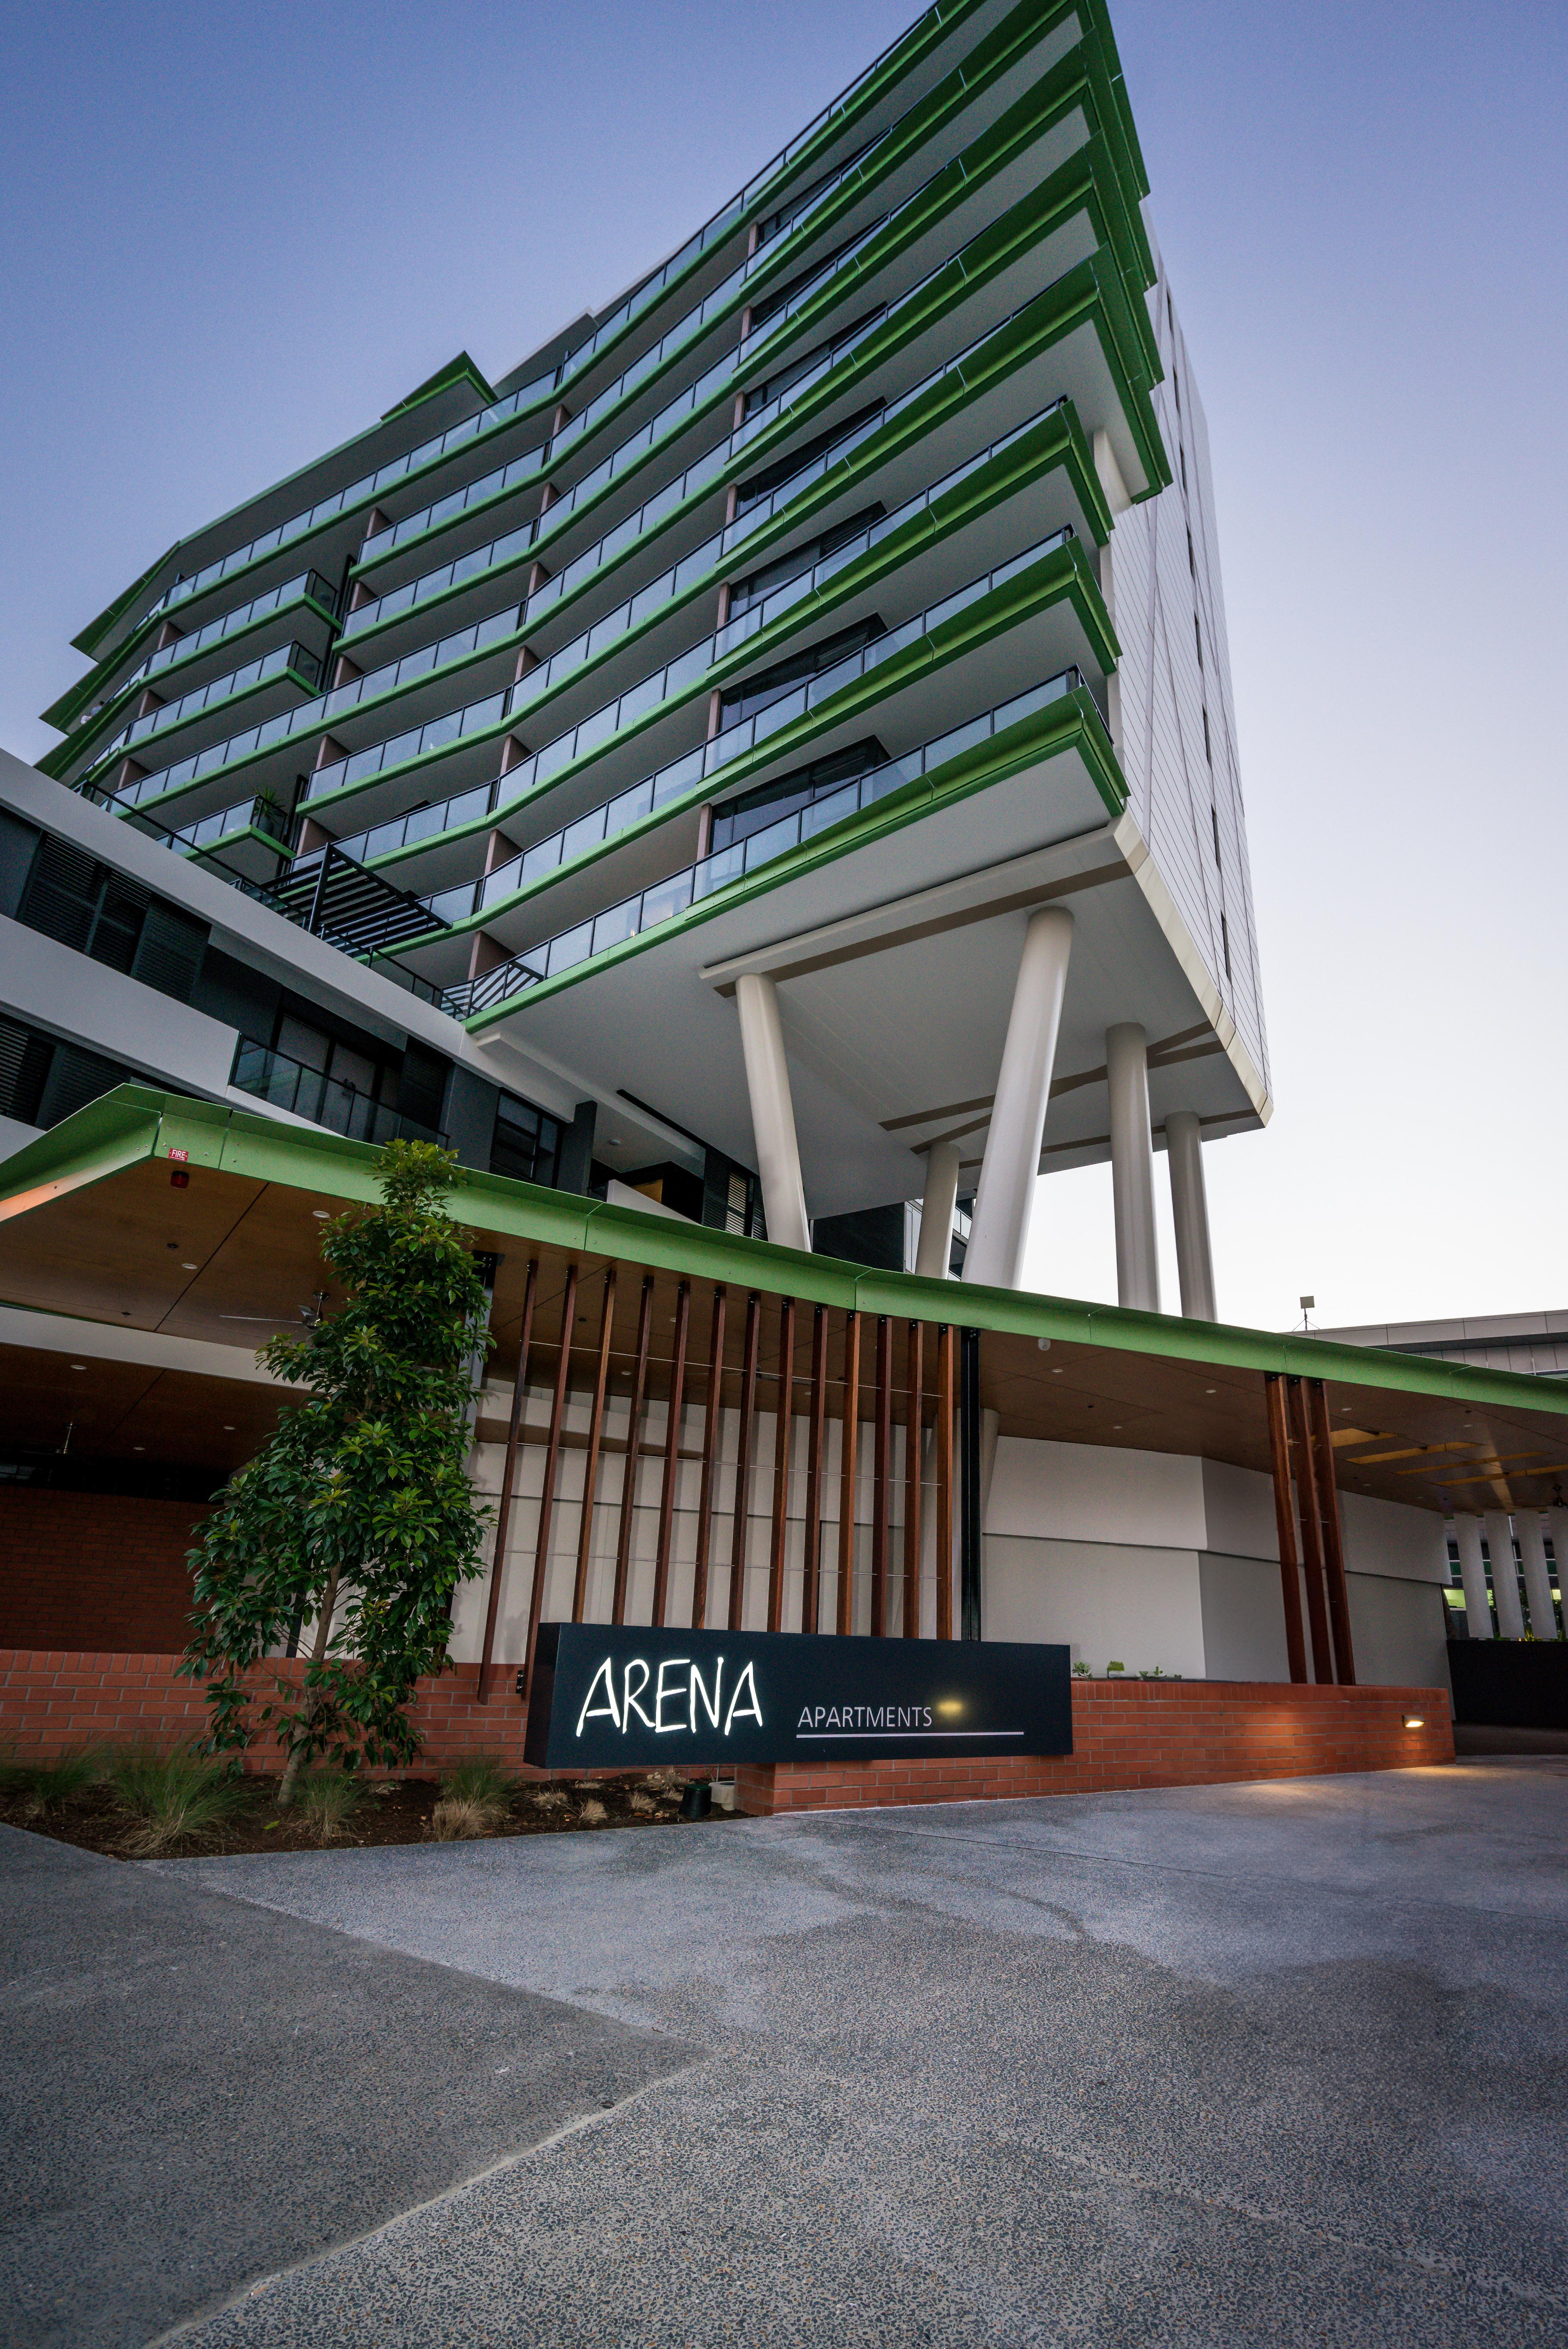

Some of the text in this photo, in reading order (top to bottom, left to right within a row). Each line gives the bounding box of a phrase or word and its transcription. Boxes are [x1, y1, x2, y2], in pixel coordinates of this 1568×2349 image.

[172, 1149, 186, 1159] FIRE
[576, 1657, 763, 1737] ARENA
[797, 1706, 933, 1728] APARTMENTS
